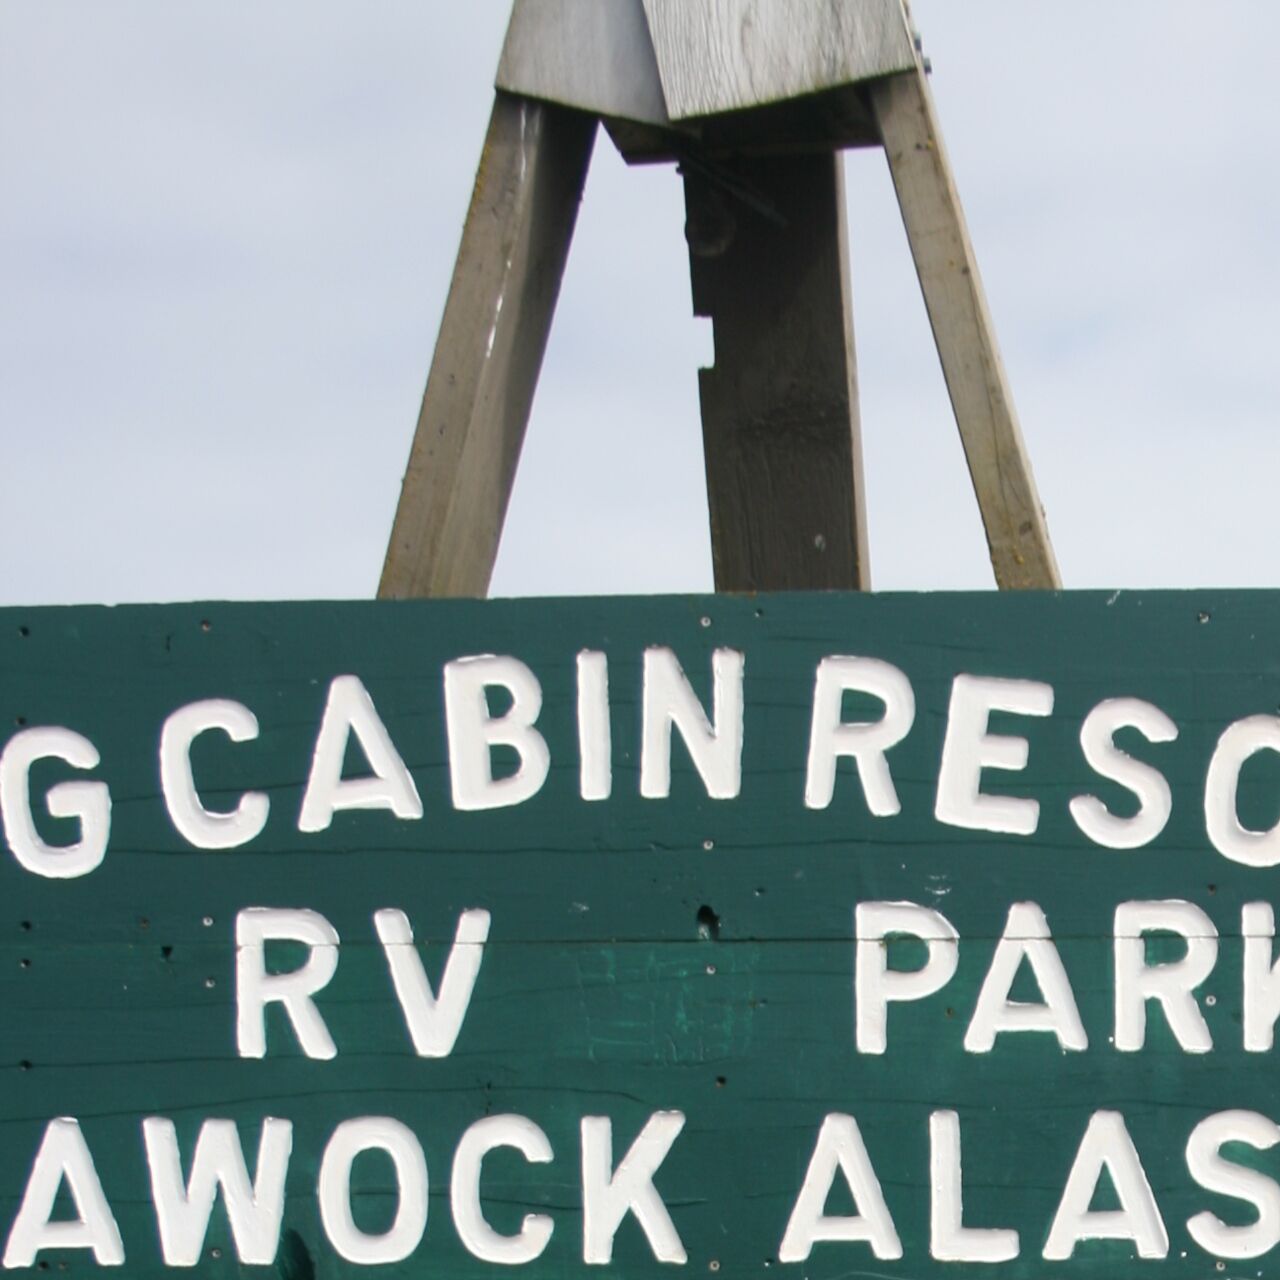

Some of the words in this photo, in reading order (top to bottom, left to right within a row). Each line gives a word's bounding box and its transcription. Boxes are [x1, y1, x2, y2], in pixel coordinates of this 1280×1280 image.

[1, 726, 112, 879] G
[159, 647, 746, 850] CABIN
[235, 906, 491, 1061] RV
[2, 1109, 688, 1269] AWOCK
